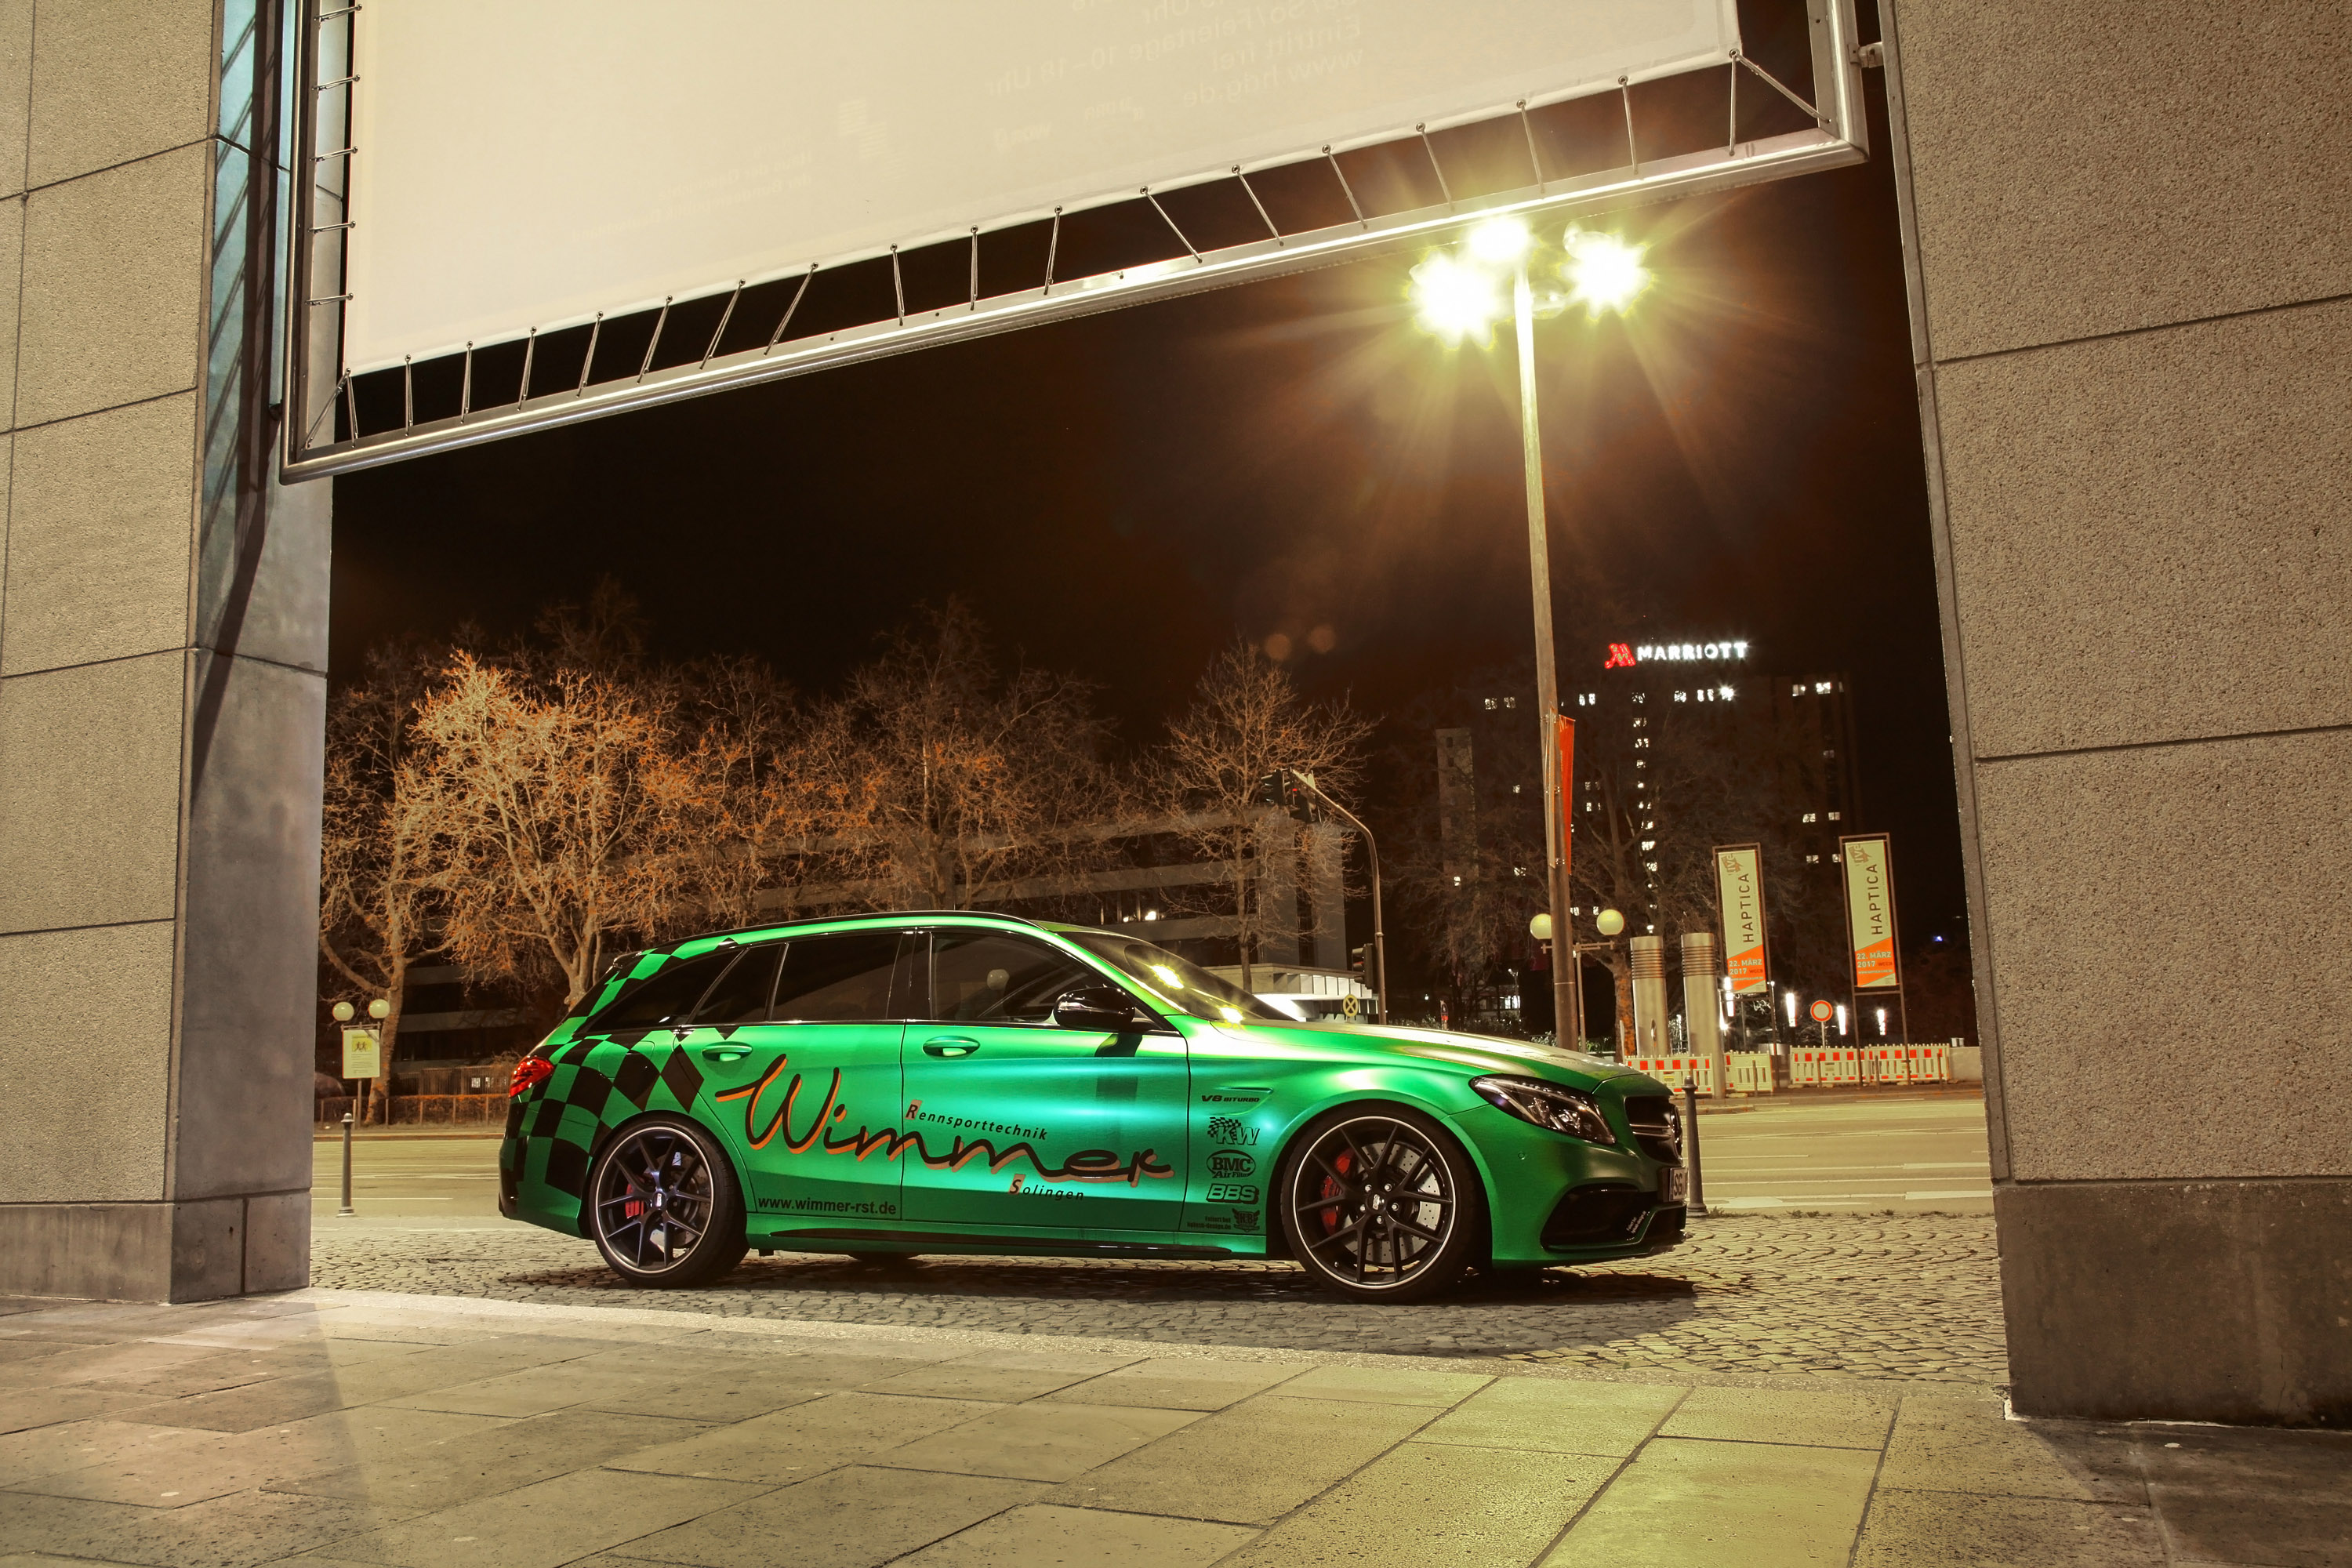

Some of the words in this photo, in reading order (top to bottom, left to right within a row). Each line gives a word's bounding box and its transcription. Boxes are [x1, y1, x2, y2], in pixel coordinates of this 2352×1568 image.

[1636, 642, 1748, 661] MARRIOTT
[1738, 873, 1755, 943] HAPTICA
[1866, 864, 1883, 935] HAPTICA
[1869, 950, 1893, 959] MÄRZ
[715, 1054, 1175, 1188] Wimmer
[906, 1101, 1048, 1141] Rennsporttechnik
[1216, 1126, 1260, 1146] KW
[1211, 1157, 1251, 1172] BMC
[1008, 1176, 1085, 1201] Solingen
[1206, 1183, 1260, 1205] BBS
[1673, 1173, 1682, 1196] SG
[758, 1197, 897, 1215] www.wimmer-rst.de
